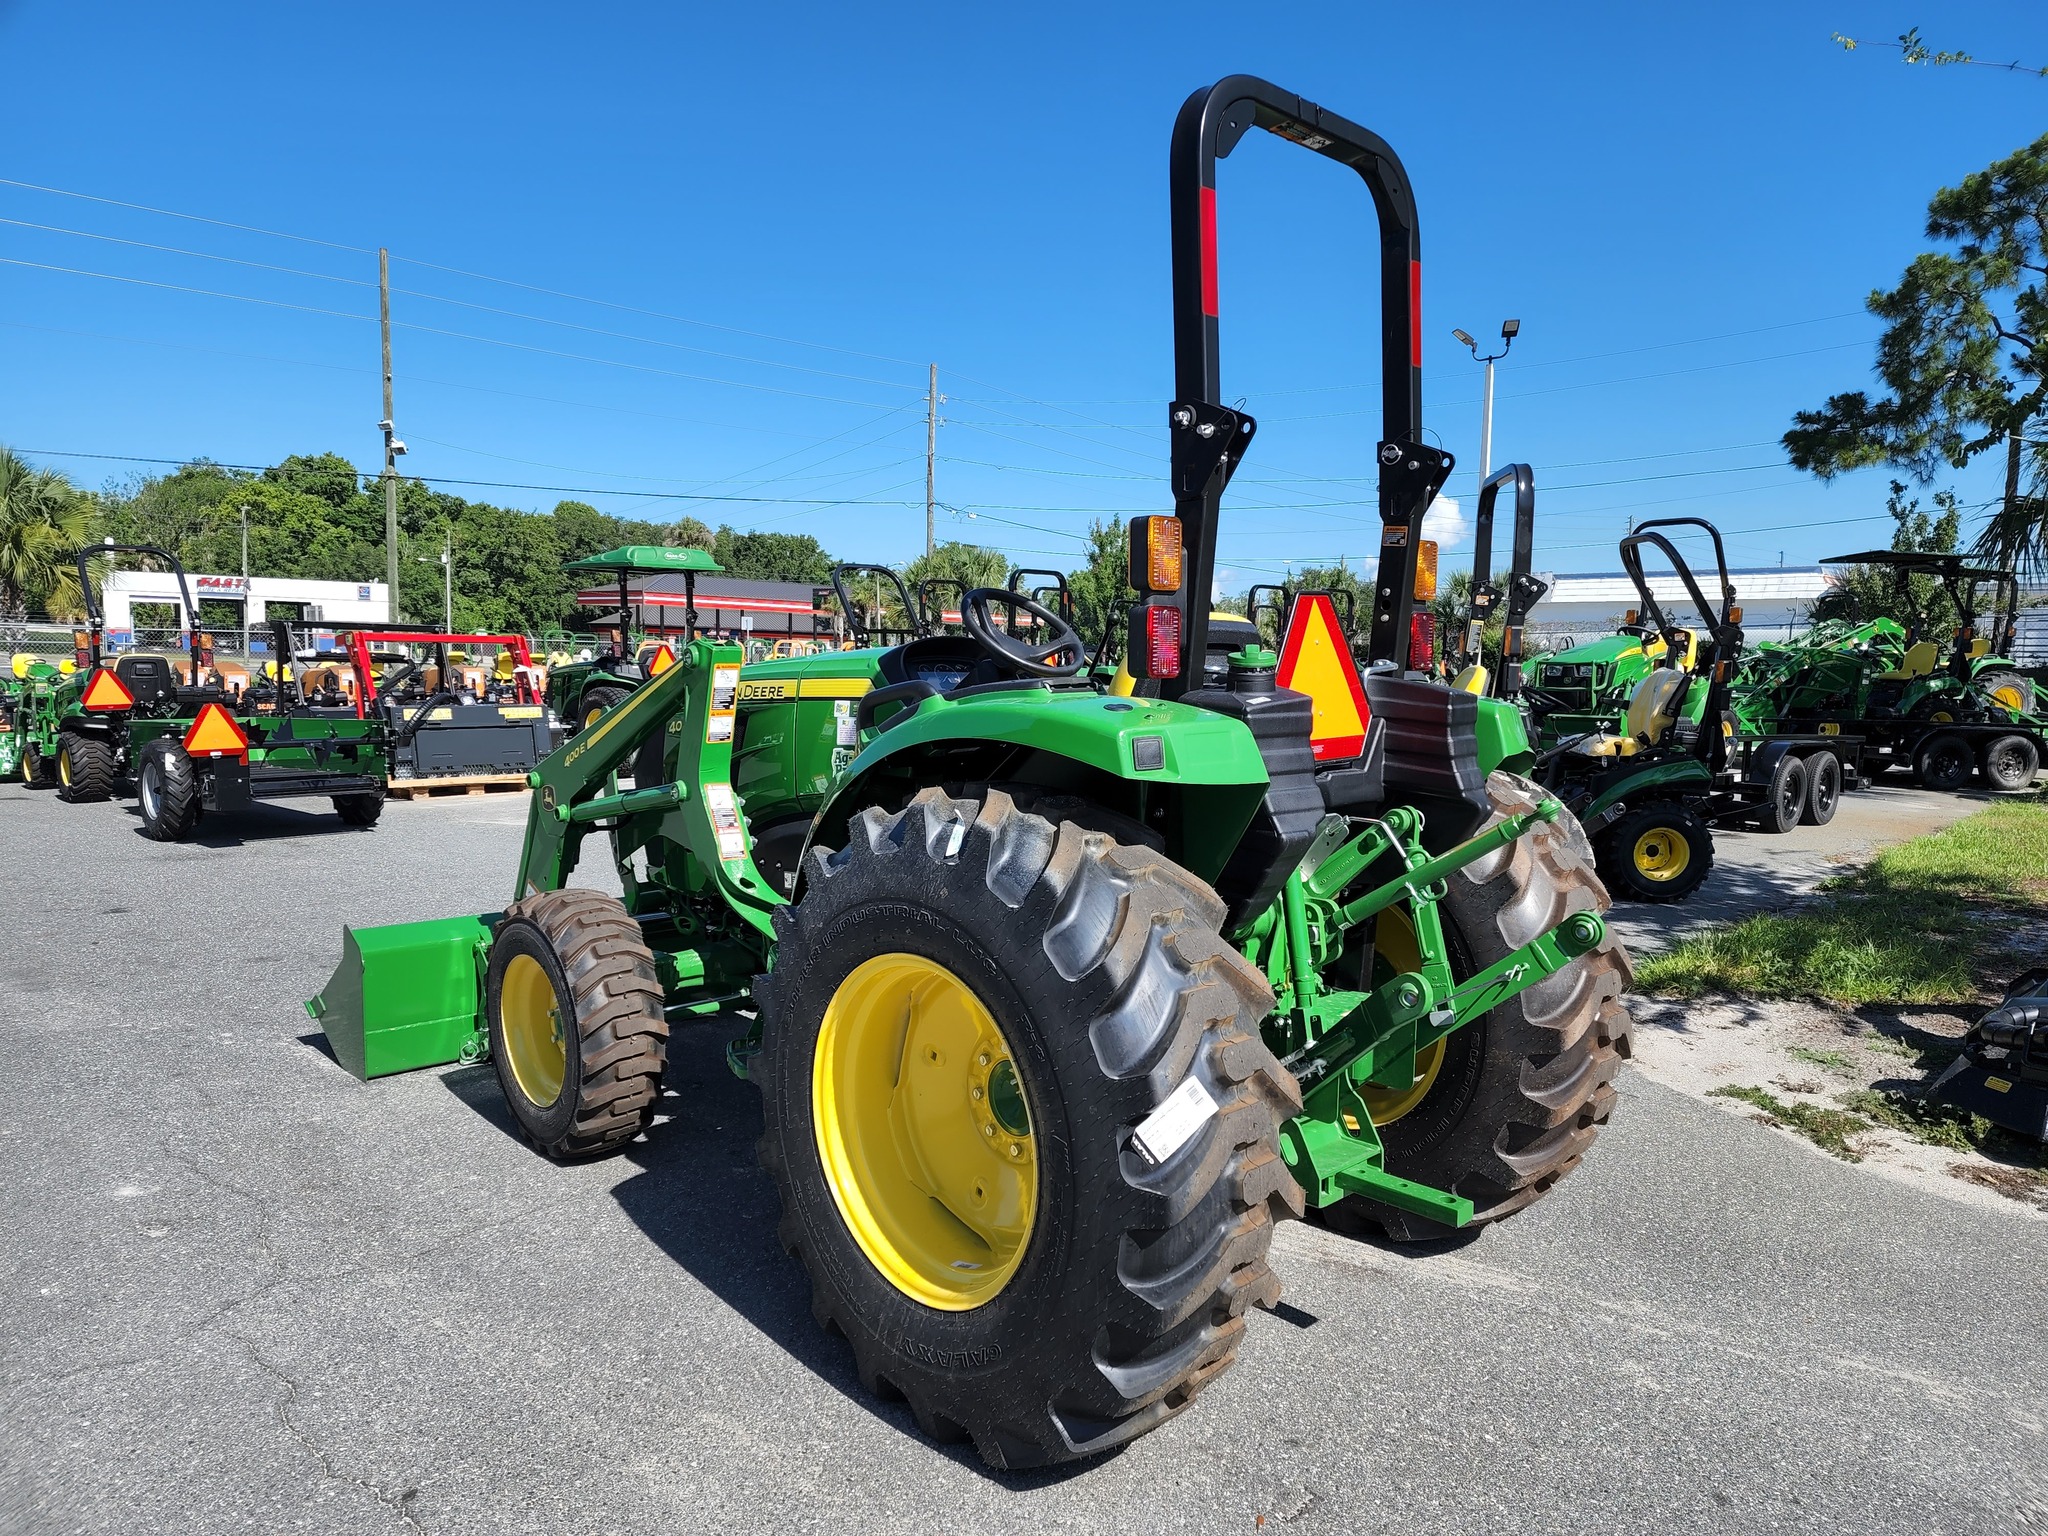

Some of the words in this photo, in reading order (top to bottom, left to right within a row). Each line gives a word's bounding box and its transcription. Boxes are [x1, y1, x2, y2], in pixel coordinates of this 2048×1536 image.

[198, 577, 244, 588] FAST
[744, 684, 785, 698] DEERE
[822, 903, 950, 948] INDUSTRIAL
[904, 1336, 1003, 1368] GALAXY
